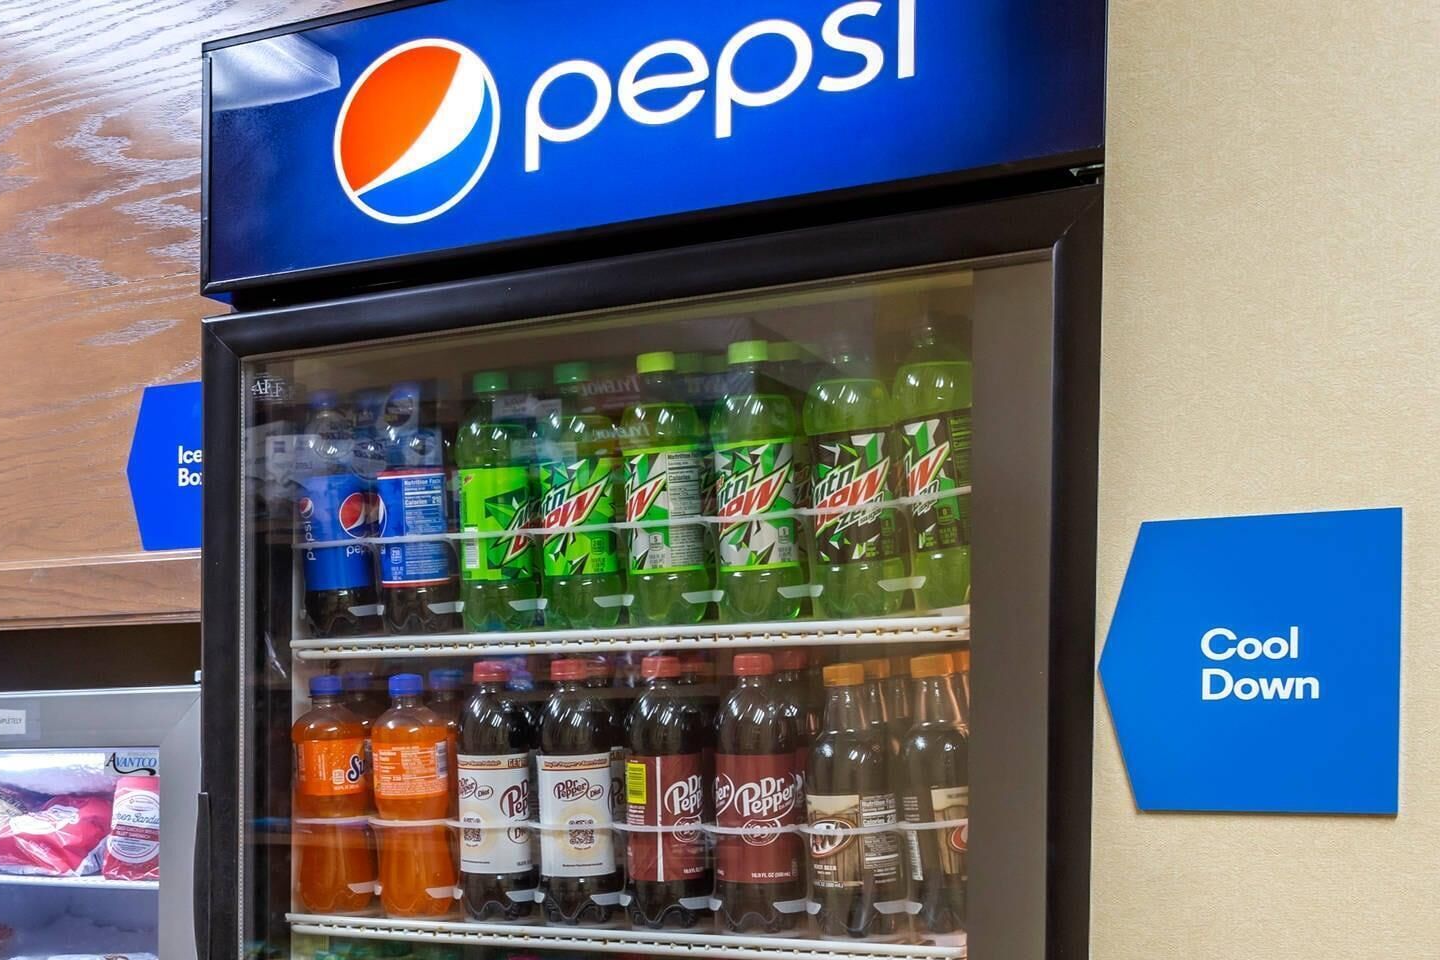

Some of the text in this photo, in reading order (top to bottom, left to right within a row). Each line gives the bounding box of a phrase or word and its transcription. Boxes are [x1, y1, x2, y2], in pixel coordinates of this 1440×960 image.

[526, 0, 917, 173] pepsi
[178, 445, 203, 465] Ice
[178, 467, 202, 486] Bo
[304, 521, 316, 560] ppsi
[1200, 626, 1299, 661] Cool
[1201, 667, 1320, 701] Down
[105, 752, 157, 774] AVANTCO
[554, 782, 587, 800] Pepper
[565, 779, 578, 790] Dr
[760, 777, 785, 799] Dr
[735, 782, 794, 817] Pepper
